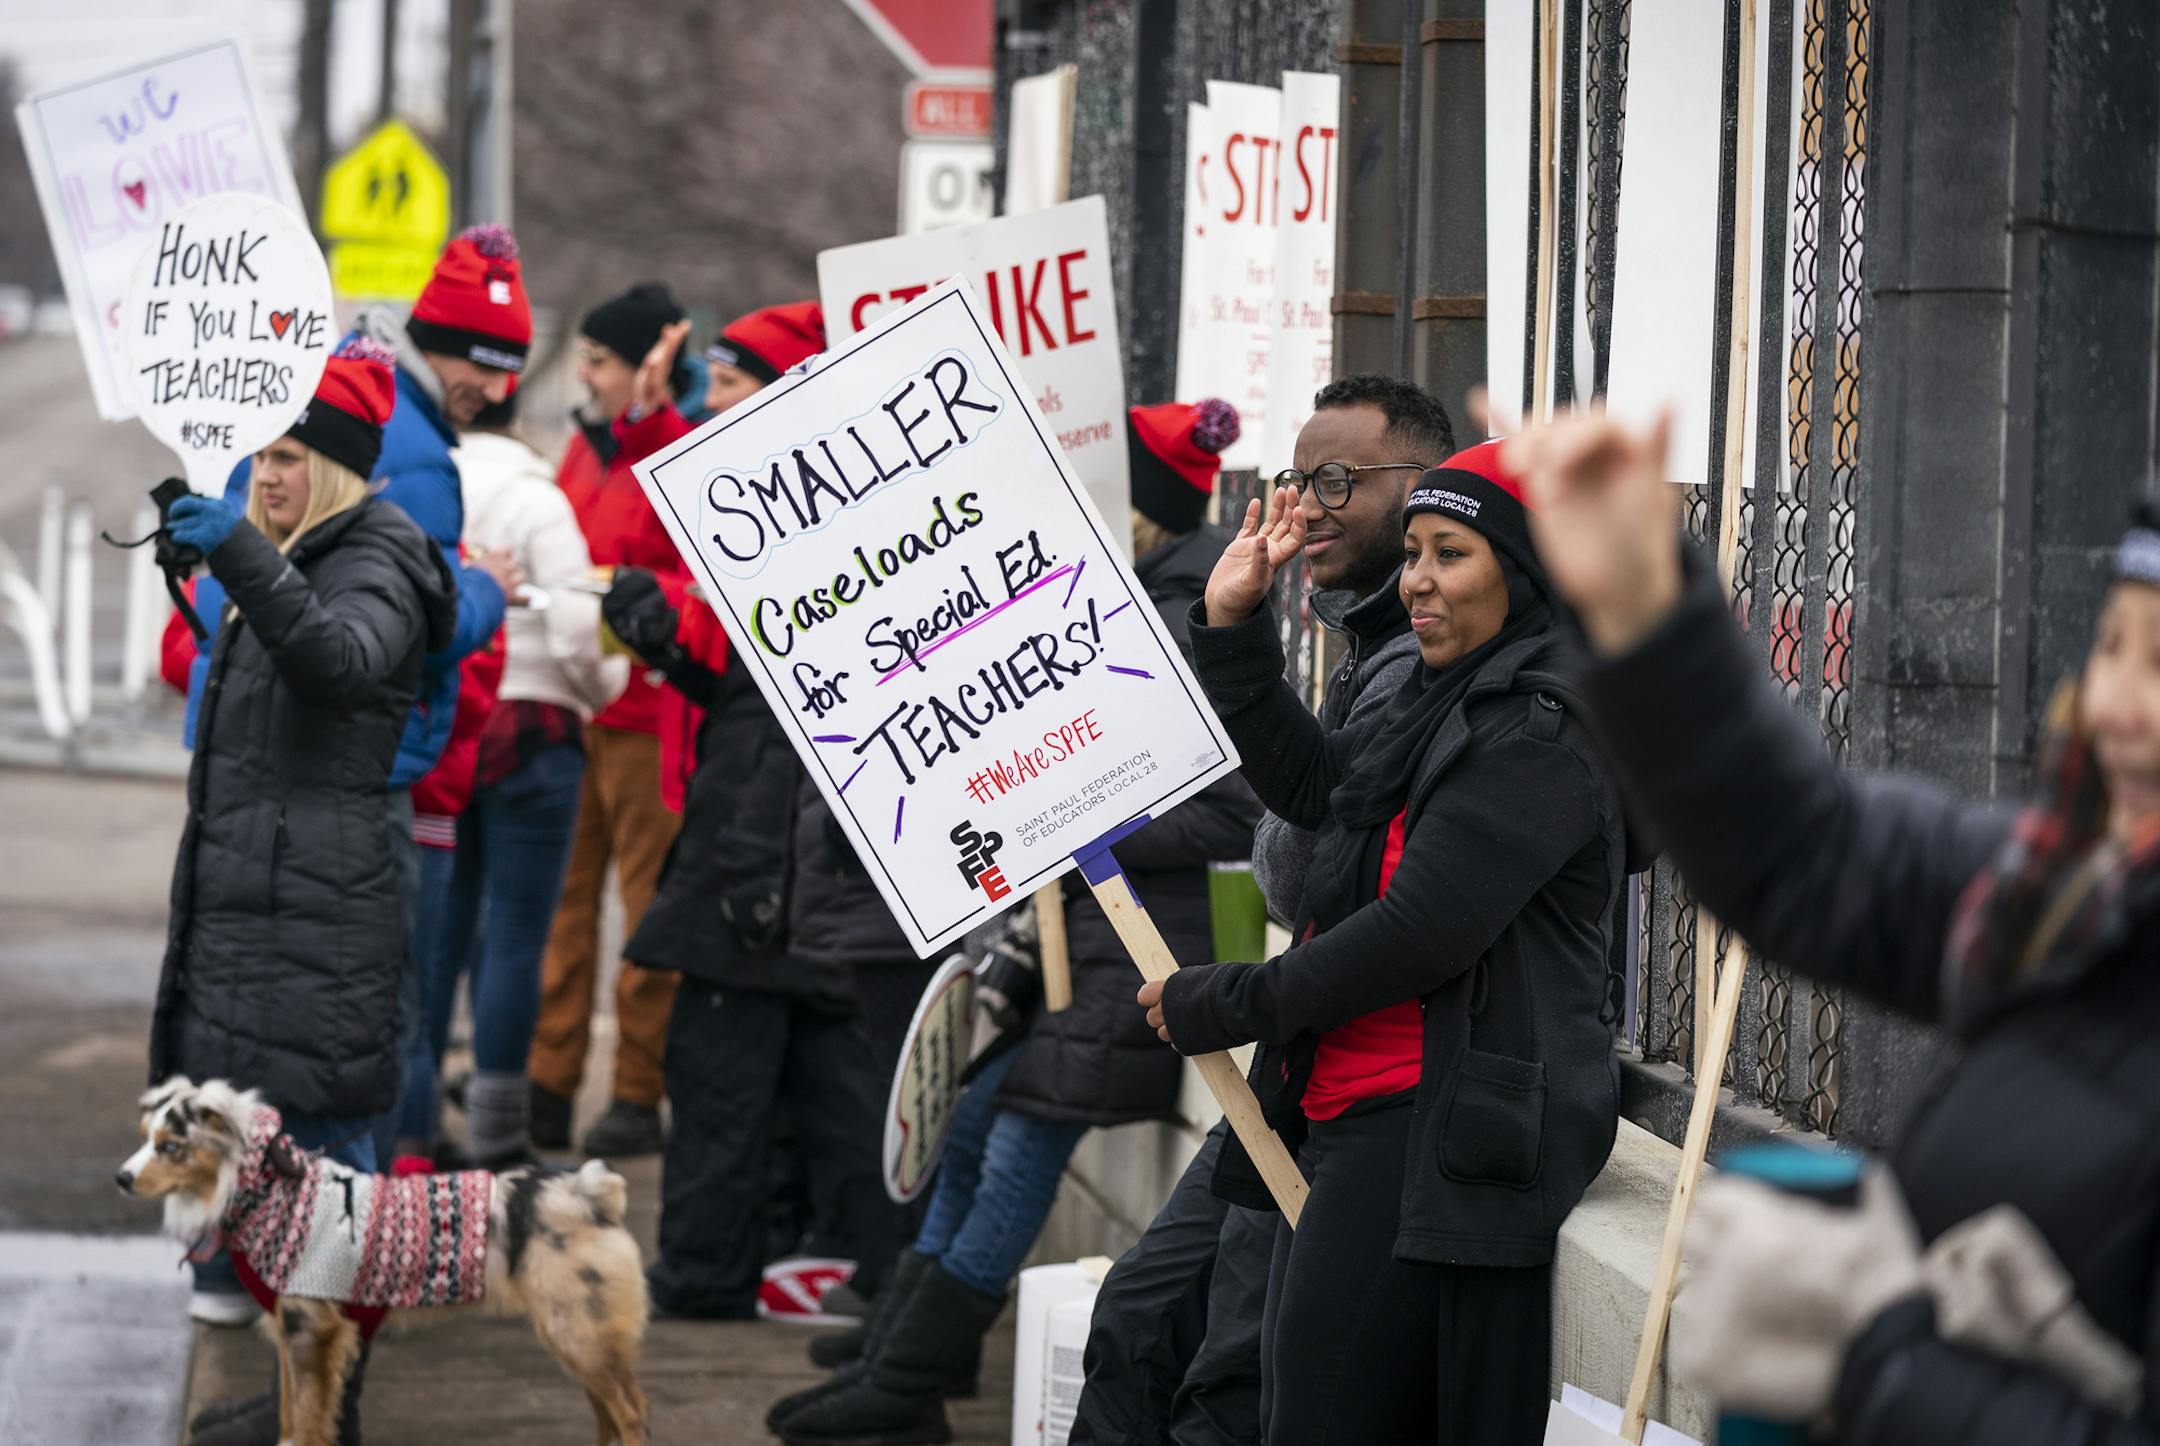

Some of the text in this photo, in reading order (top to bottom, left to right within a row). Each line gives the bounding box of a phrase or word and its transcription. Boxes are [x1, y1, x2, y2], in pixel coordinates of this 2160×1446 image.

[154, 223, 268, 287] HONK
[144, 301, 169, 335] IF
[850, 249, 1096, 357] IKE
[141, 357, 294, 408] TEACHERS
[180, 420, 235, 449] #SPFE
[709, 357, 998, 562] SMALLER
[1056, 421, 1112, 452] eserve
[1431, 489, 1482, 510] FEDERATION
[751, 492, 984, 659] Caseloads
[793, 530, 1057, 719] for Special Ed.
[853, 598, 1105, 785] TEACHERS!
[1015, 750, 1152, 837] SAINT PAUL FEDERATION
[1022, 761, 1159, 848] OF EDUCATORS LOCAL 28
